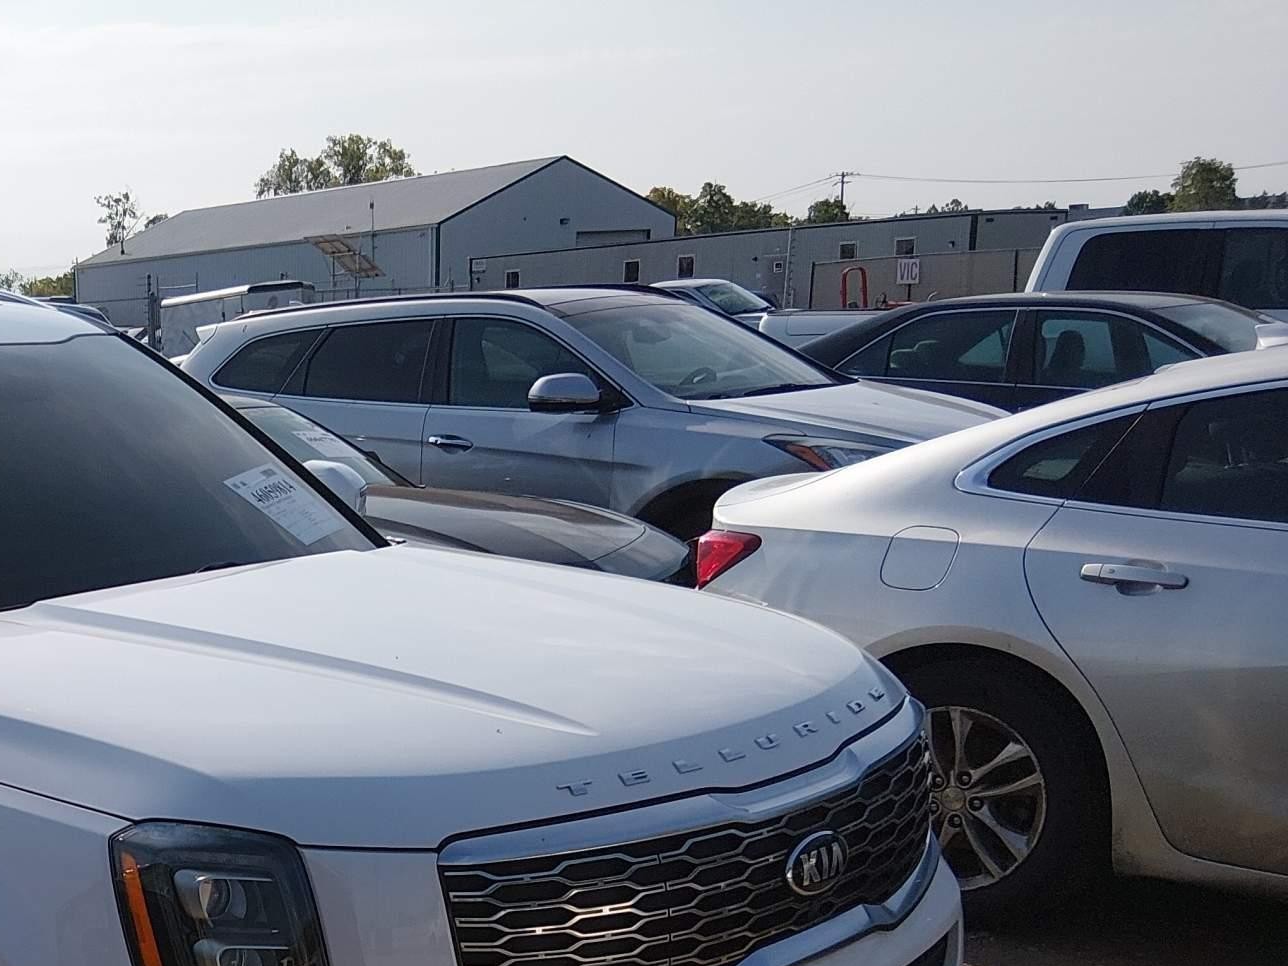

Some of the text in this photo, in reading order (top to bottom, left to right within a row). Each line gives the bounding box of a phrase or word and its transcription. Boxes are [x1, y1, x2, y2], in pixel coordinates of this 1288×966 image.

[900, 261, 918, 281] VIC
[556, 686, 886, 796] TELLURIDE
[800, 841, 844, 887] KIA
